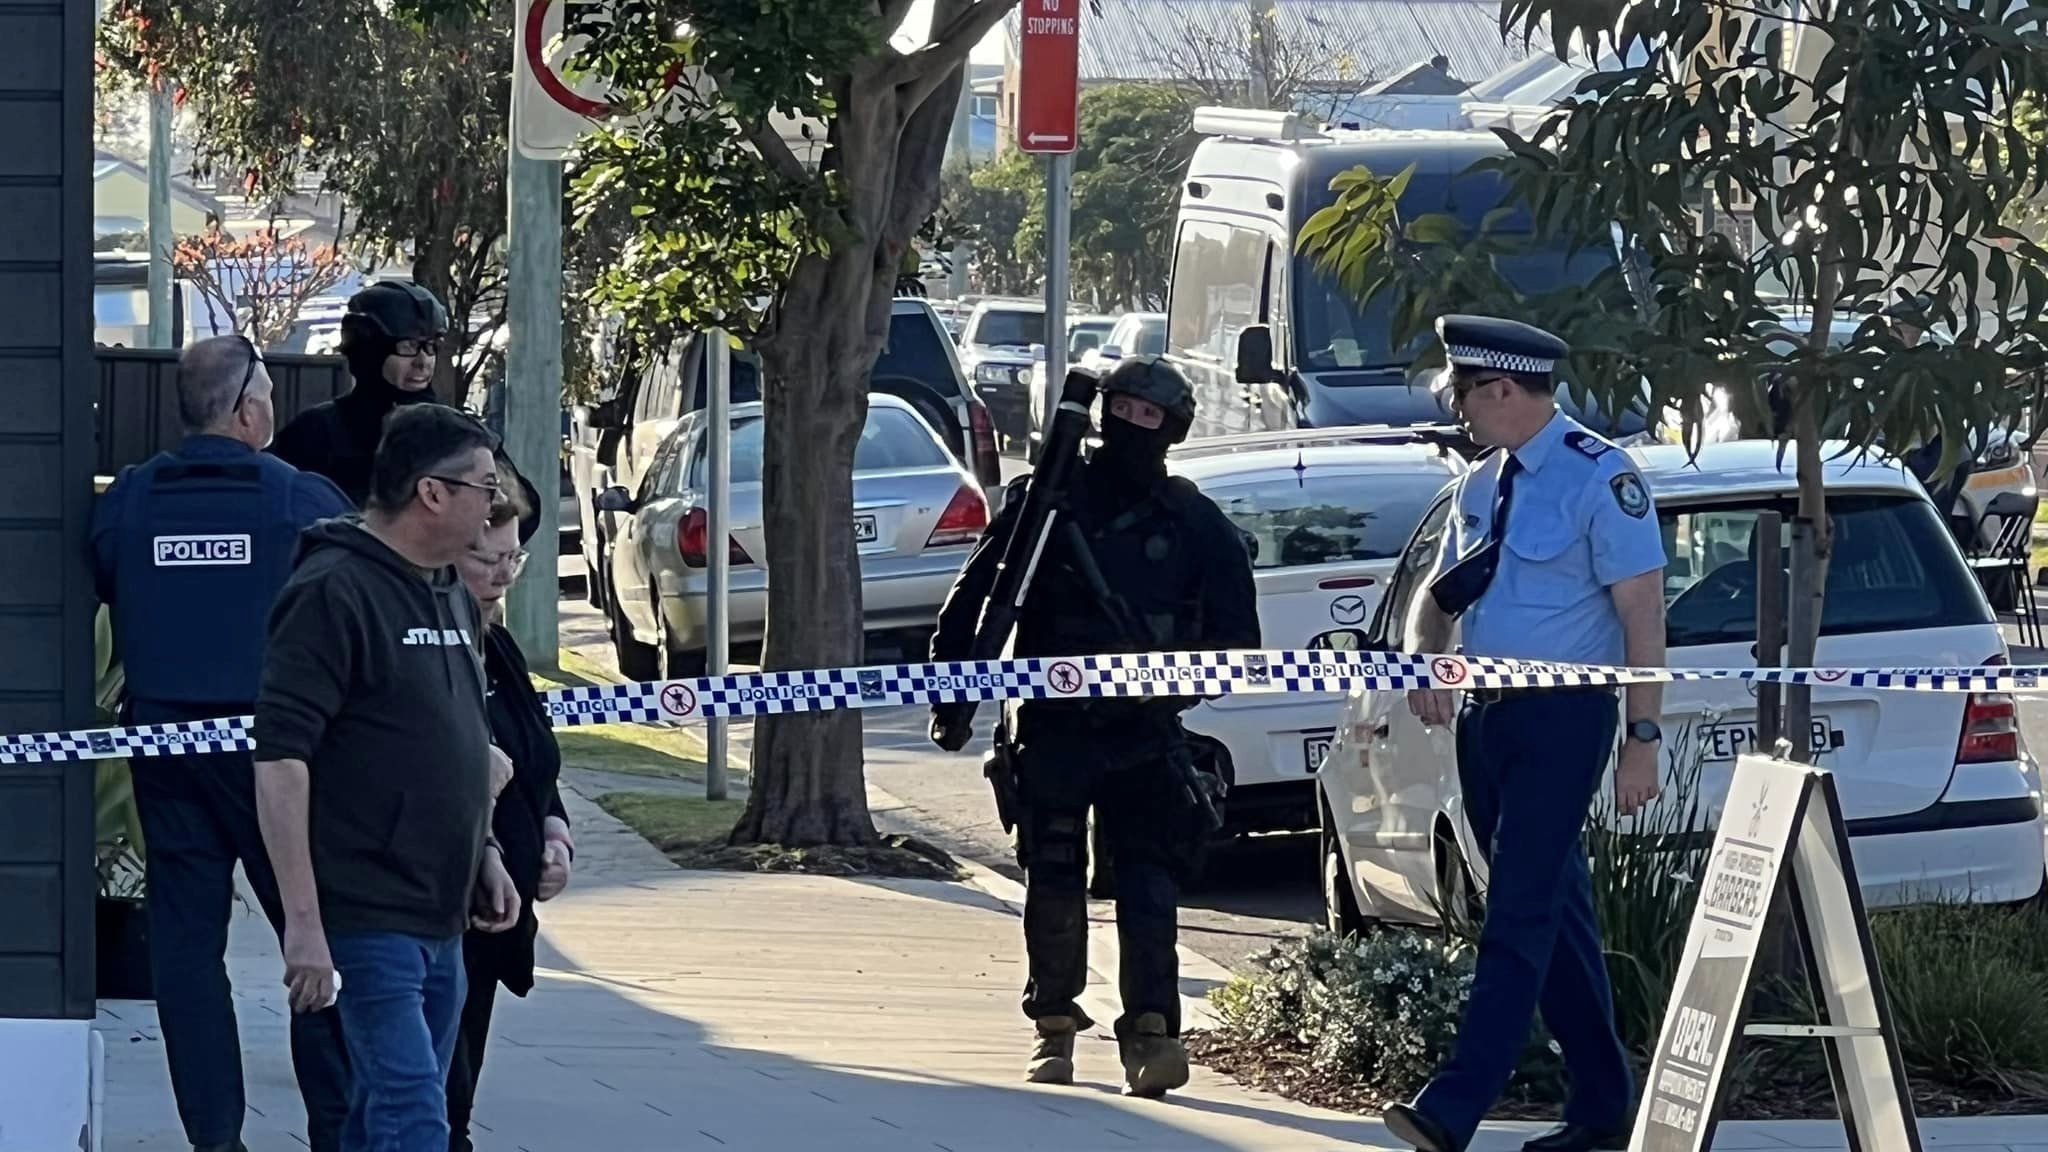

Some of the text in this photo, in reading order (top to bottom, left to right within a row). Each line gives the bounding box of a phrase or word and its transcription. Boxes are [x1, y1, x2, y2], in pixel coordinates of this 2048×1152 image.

[1043, 0, 1060, 11] NO
[1028, 17, 1074, 35] STOPPING
[159, 541, 244, 560] POLICE
[928, 675, 1002, 689] POLICE
[1127, 668, 1201, 680] POLICE
[740, 685, 818, 701] POLICE
[1711, 722, 1827, 756] EPNB
[0, 743, 48, 754] LICE
[1711, 872, 1761, 917] BARBERS
